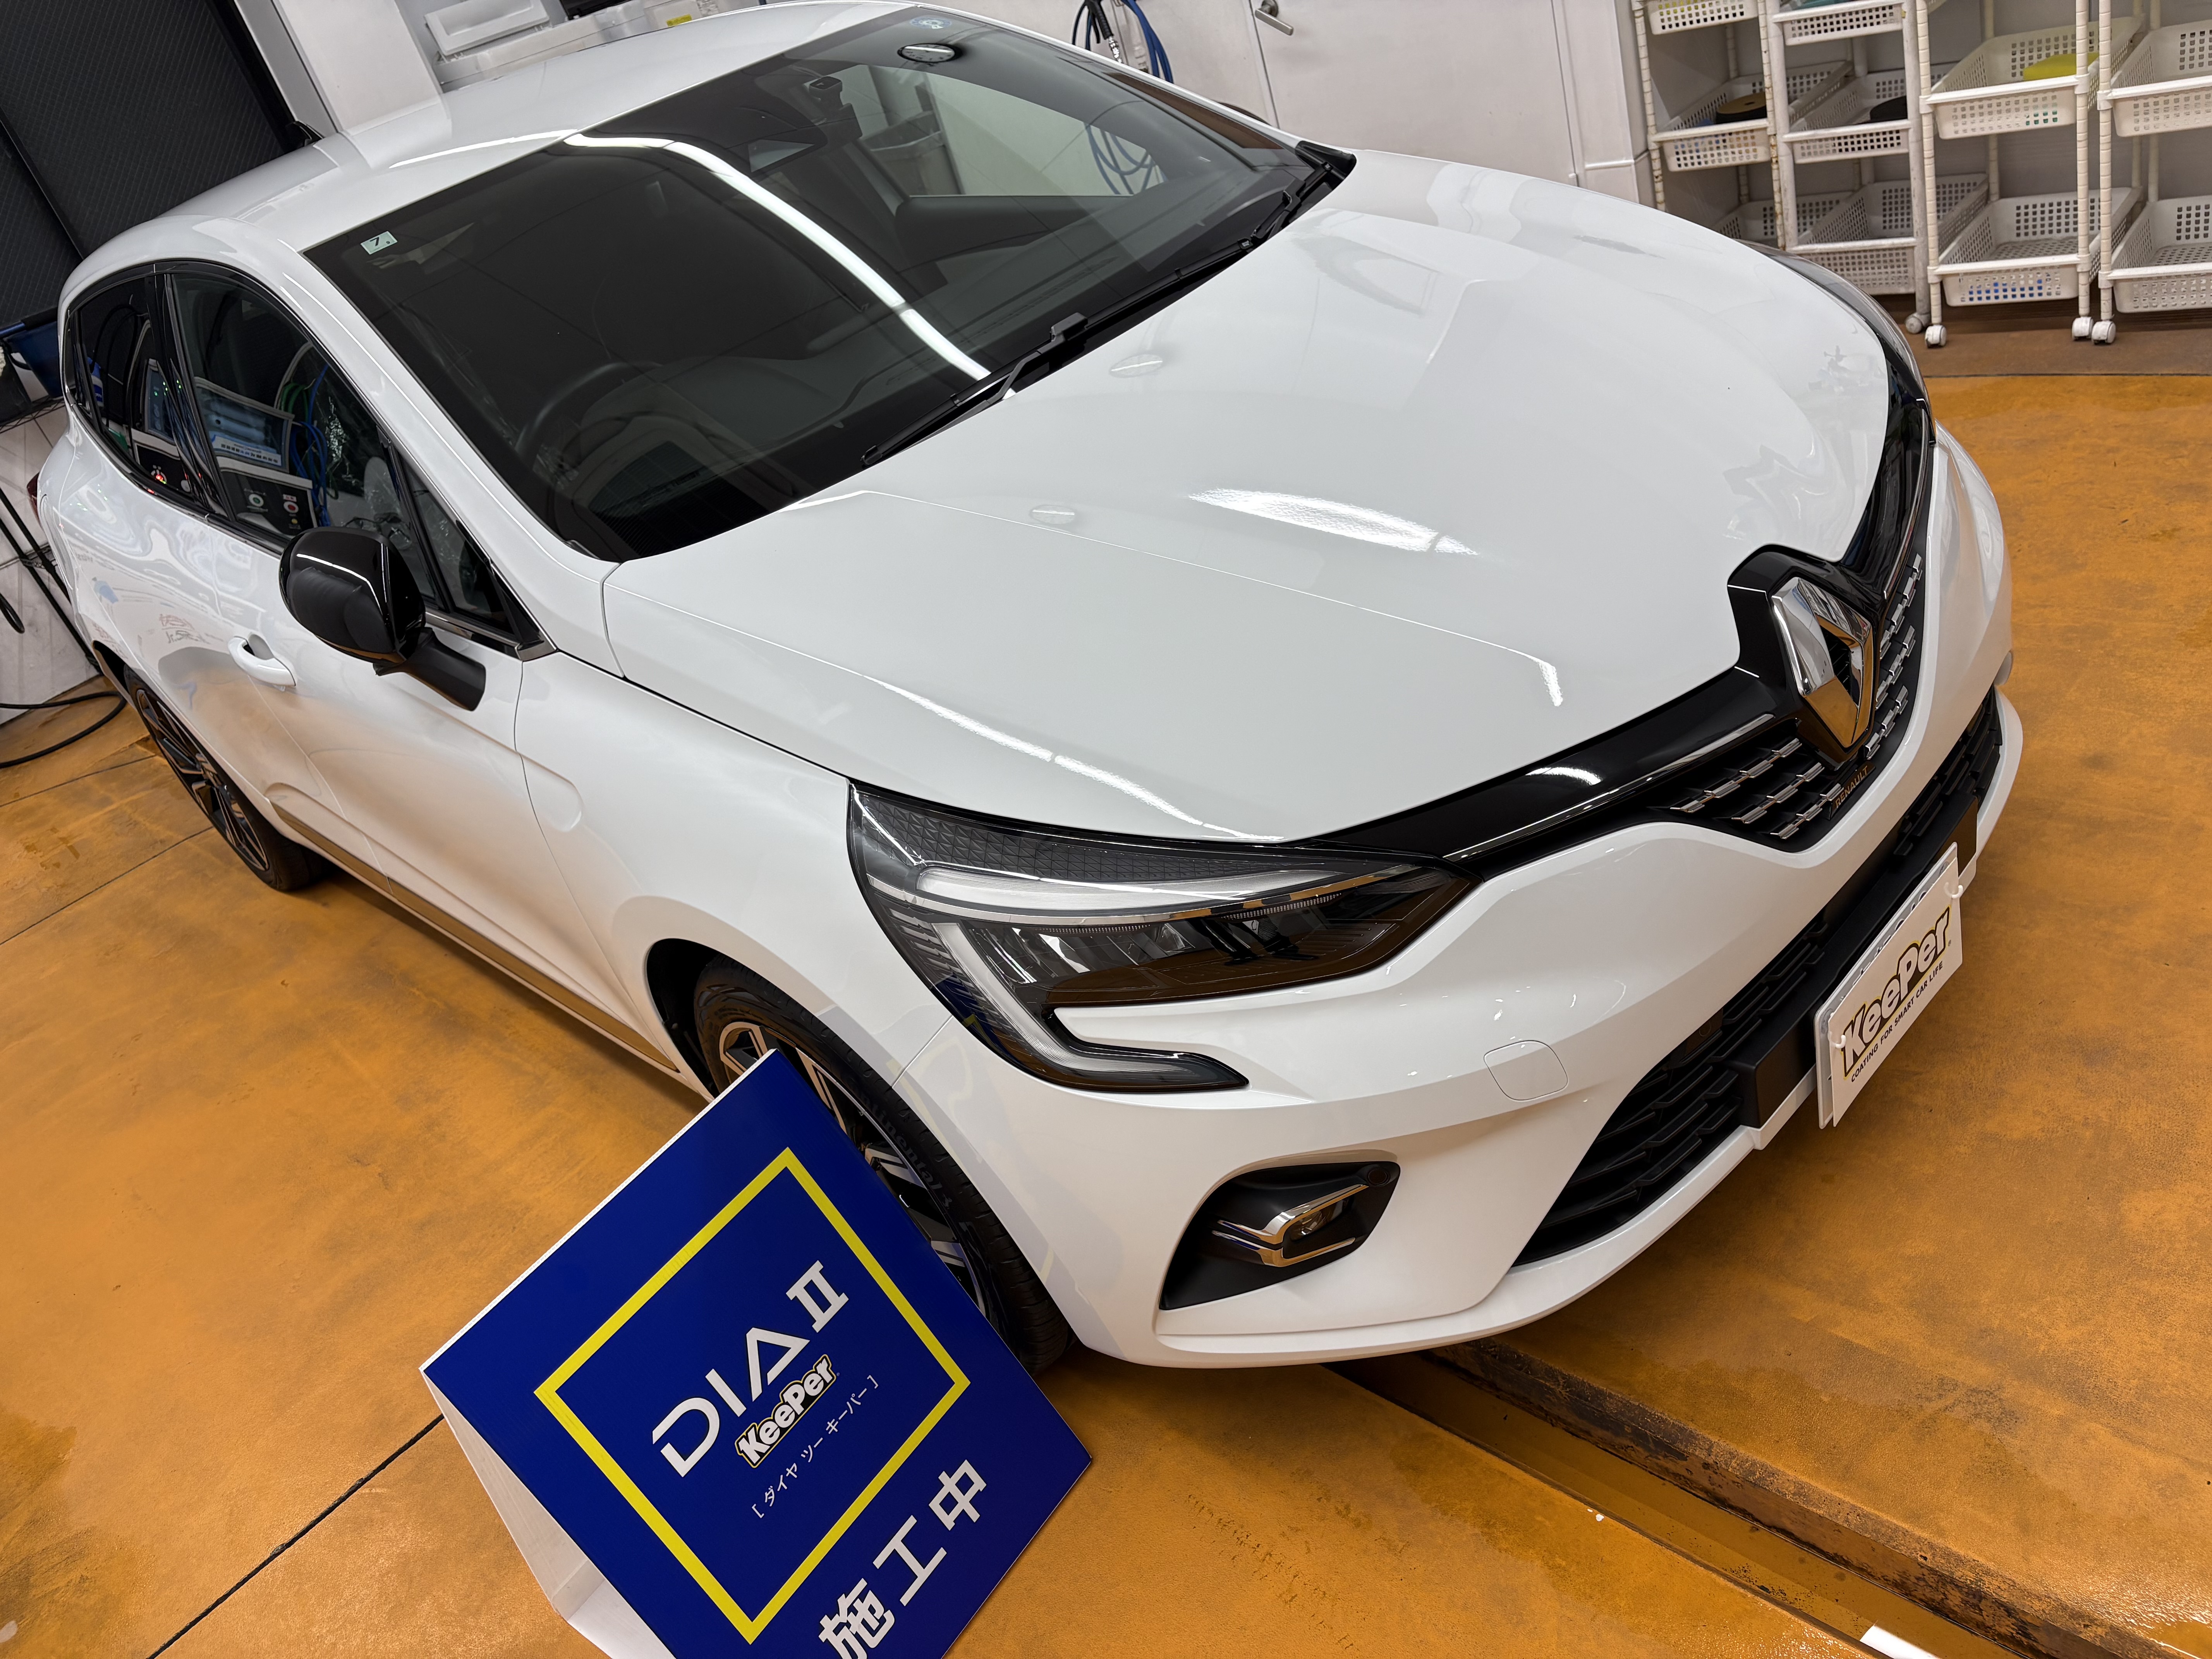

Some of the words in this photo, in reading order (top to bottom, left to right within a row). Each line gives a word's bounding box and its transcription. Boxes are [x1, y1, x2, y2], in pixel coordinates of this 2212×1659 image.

[369, 237, 380, 246] 7
[1836, 765, 1868, 809] RENAULT
[1840, 905, 1951, 1078] KeePer
[1851, 1043, 1879, 1082] COATING
[1881, 1025, 1893, 1045] FOR
[1894, 996, 1914, 1027] SMART
[1916, 980, 1928, 998] CAR
[1929, 960, 1943, 982] LIFE
[842, 1070, 944, 1190] ntinental
[736, 1355, 835, 1467] KeePer
[819, 1459, 987, 1659] 施工中
